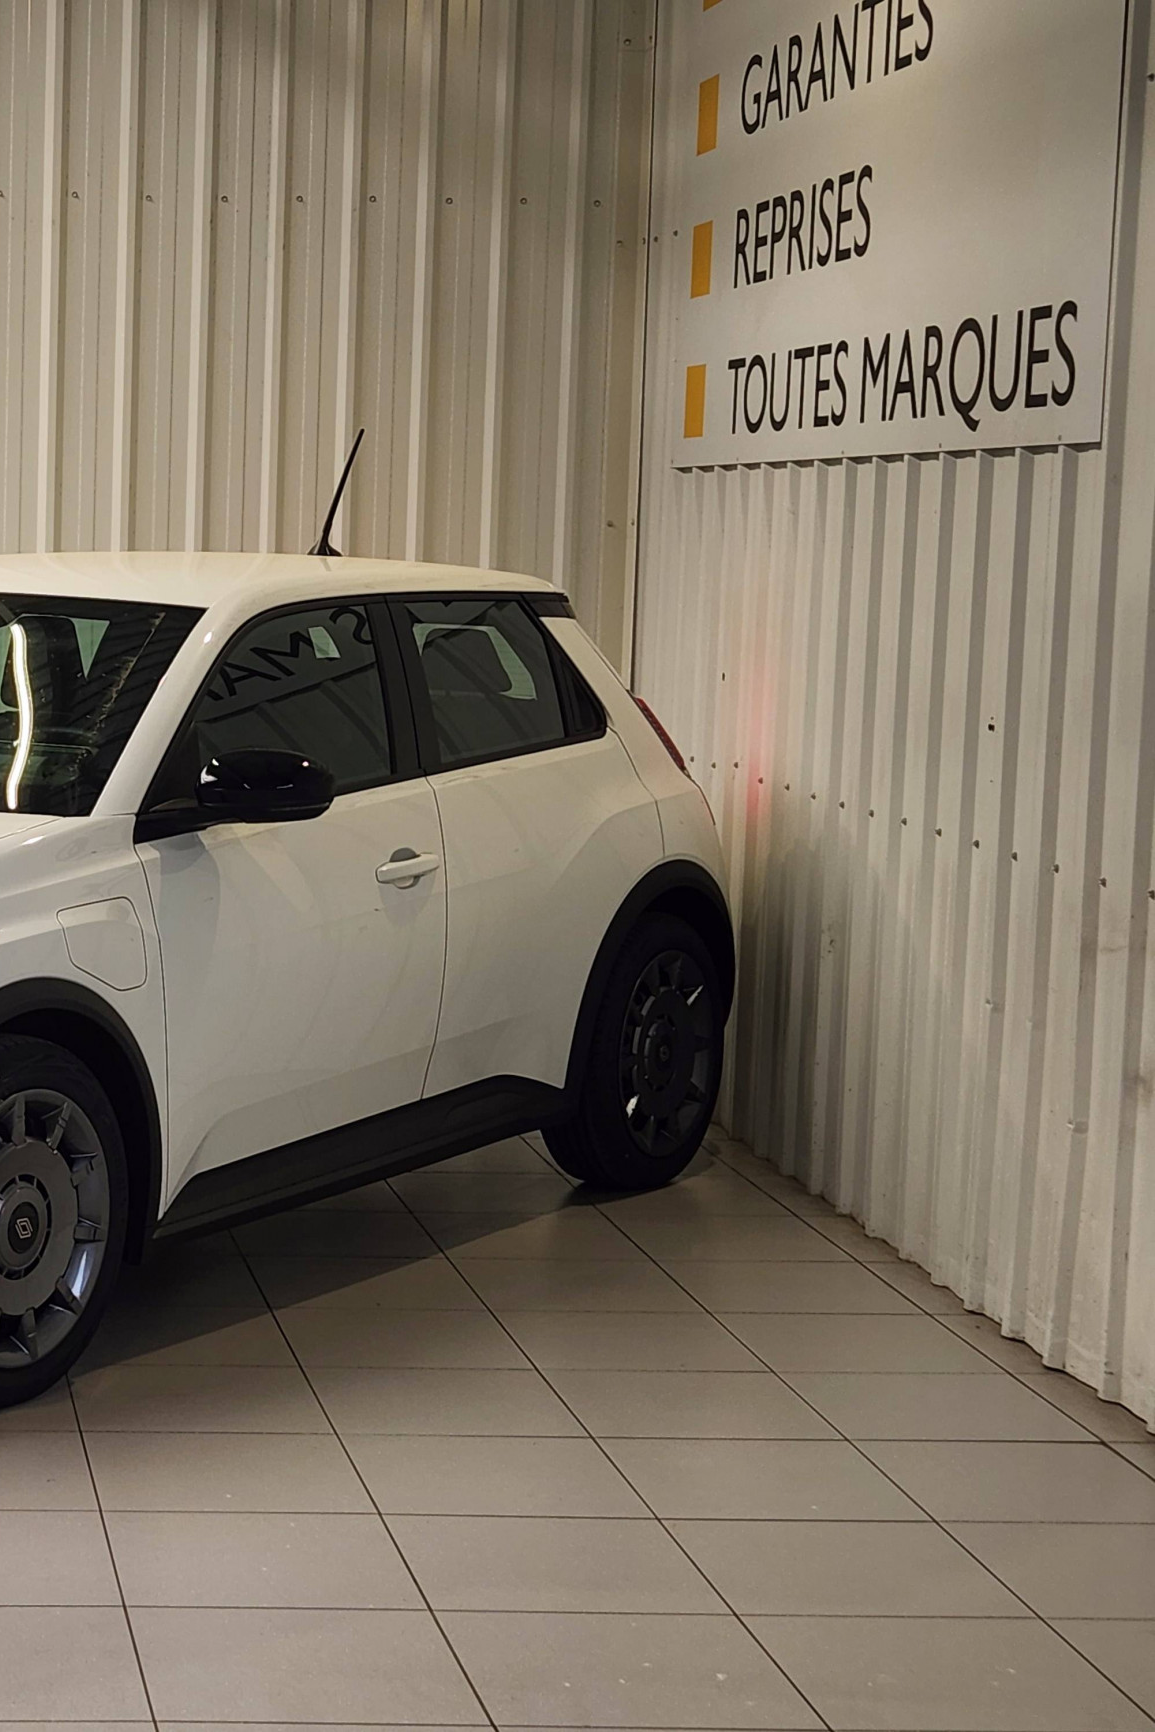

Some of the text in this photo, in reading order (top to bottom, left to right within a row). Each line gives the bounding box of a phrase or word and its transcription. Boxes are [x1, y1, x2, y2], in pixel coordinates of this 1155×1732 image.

[741, 0, 934, 135] GARANTIES
[733, 165, 873, 289] REPRISES
[728, 300, 1078, 434] TOUTES MARQUES
